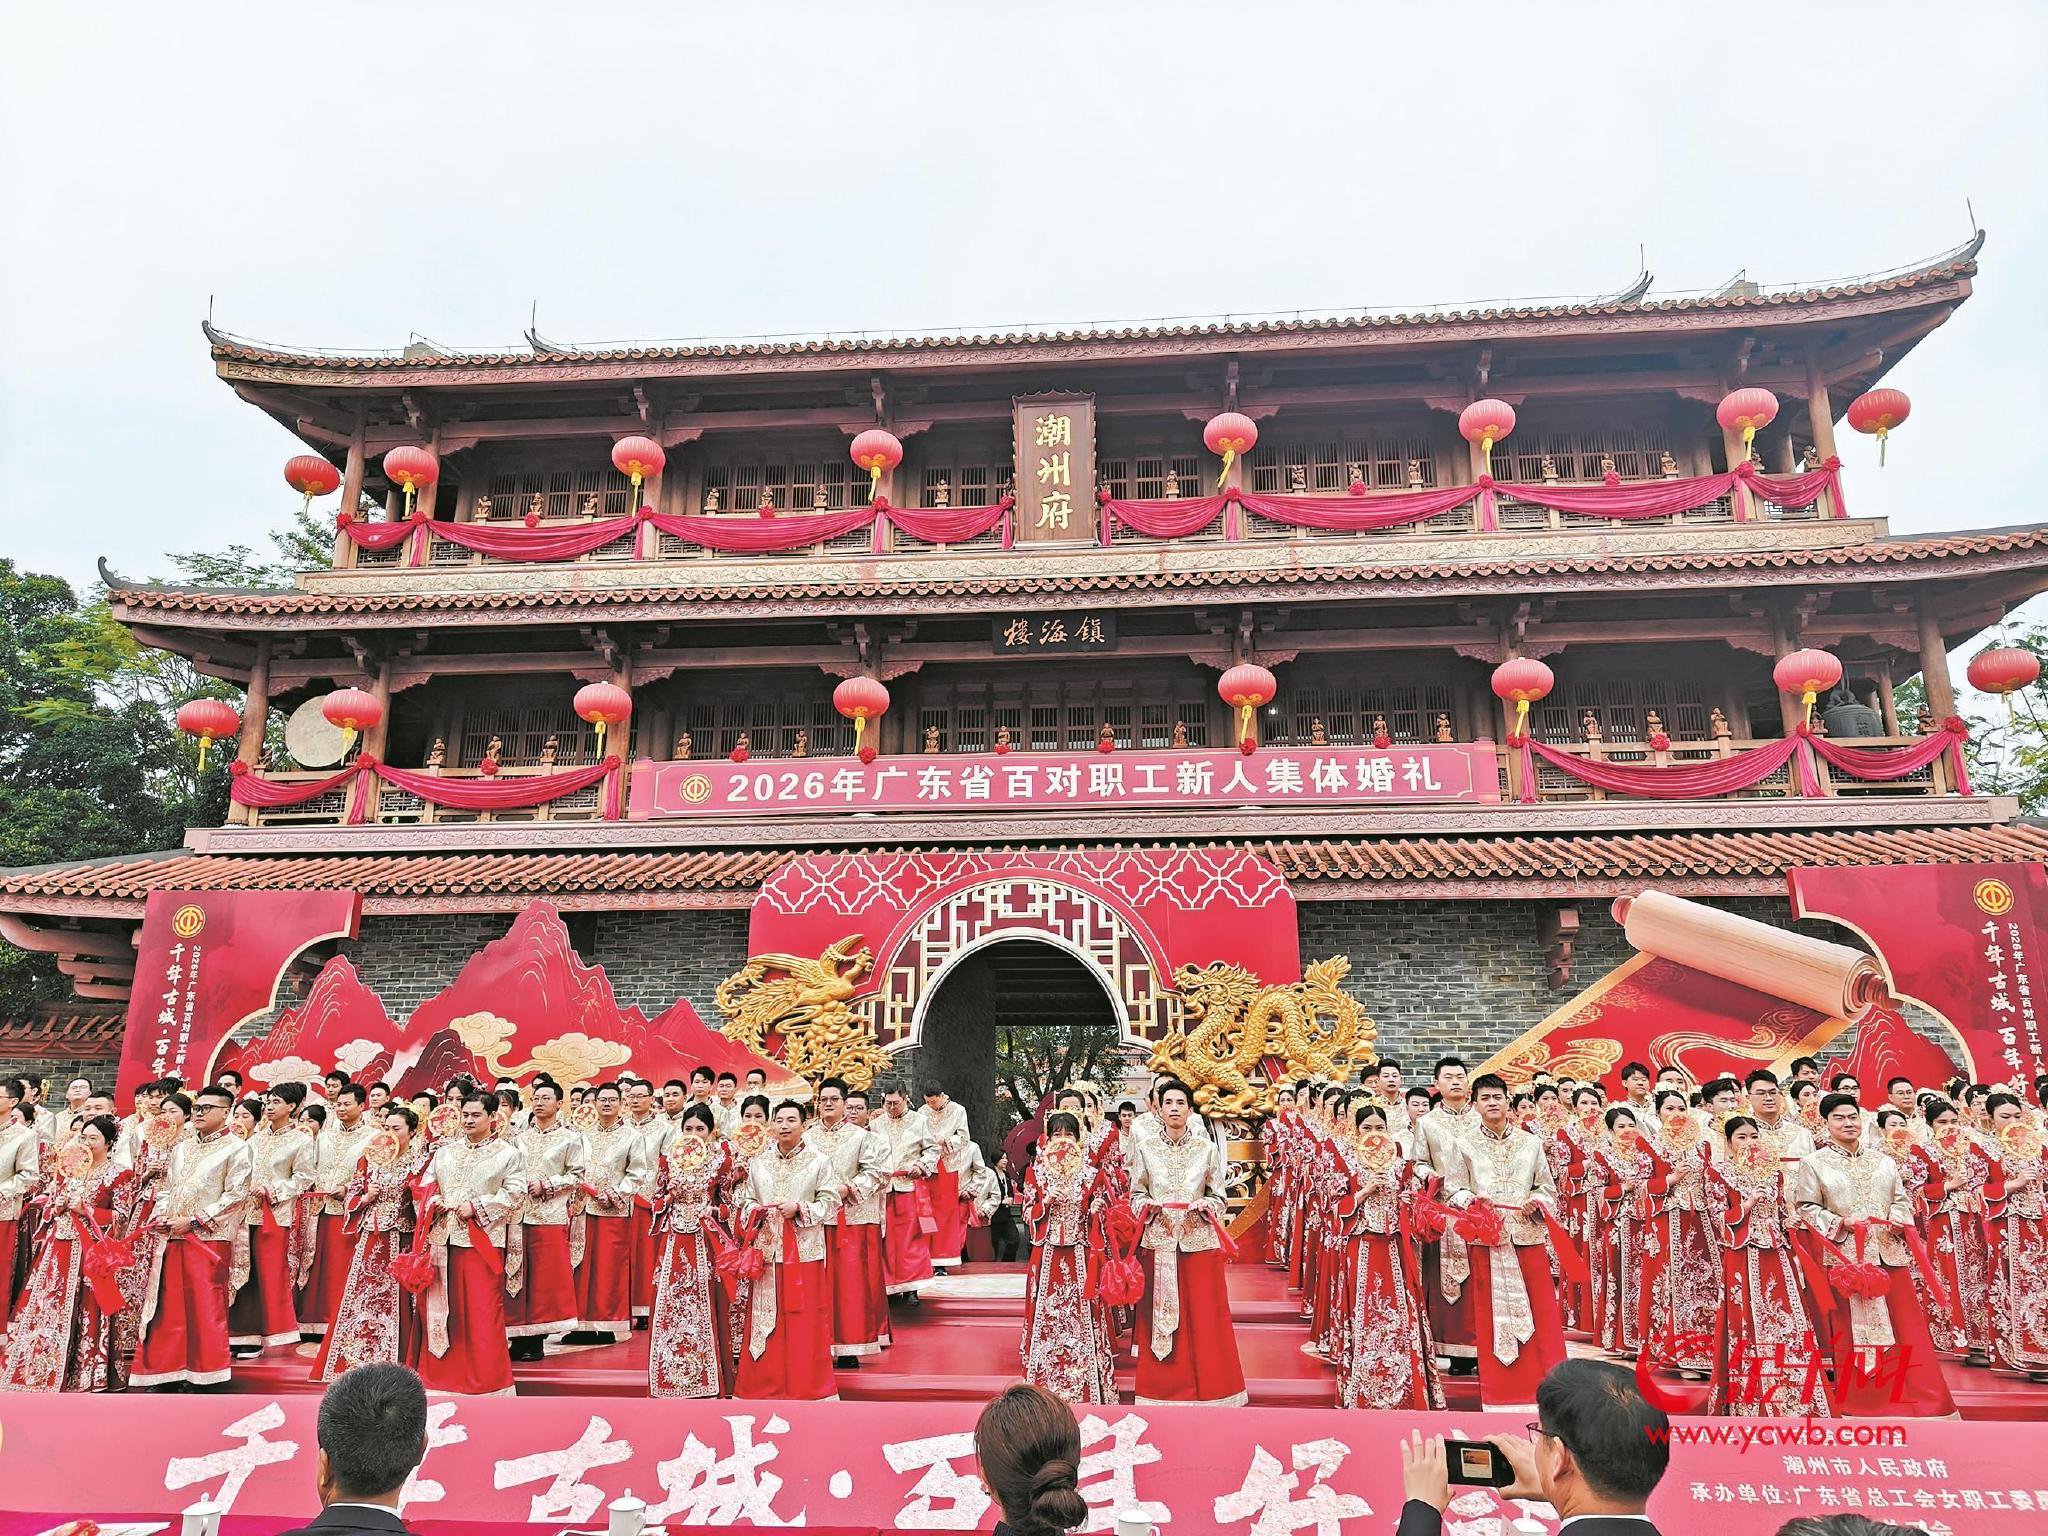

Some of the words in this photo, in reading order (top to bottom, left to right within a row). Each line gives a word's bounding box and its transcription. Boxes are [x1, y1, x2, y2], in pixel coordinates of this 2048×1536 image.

[1034, 413, 1074, 530] 潮州府
[726, 755, 1442, 801] 2026年广东省百对职工新人集体婚礼
[1782, 1455, 1949, 1479] 潮州市人民政府
